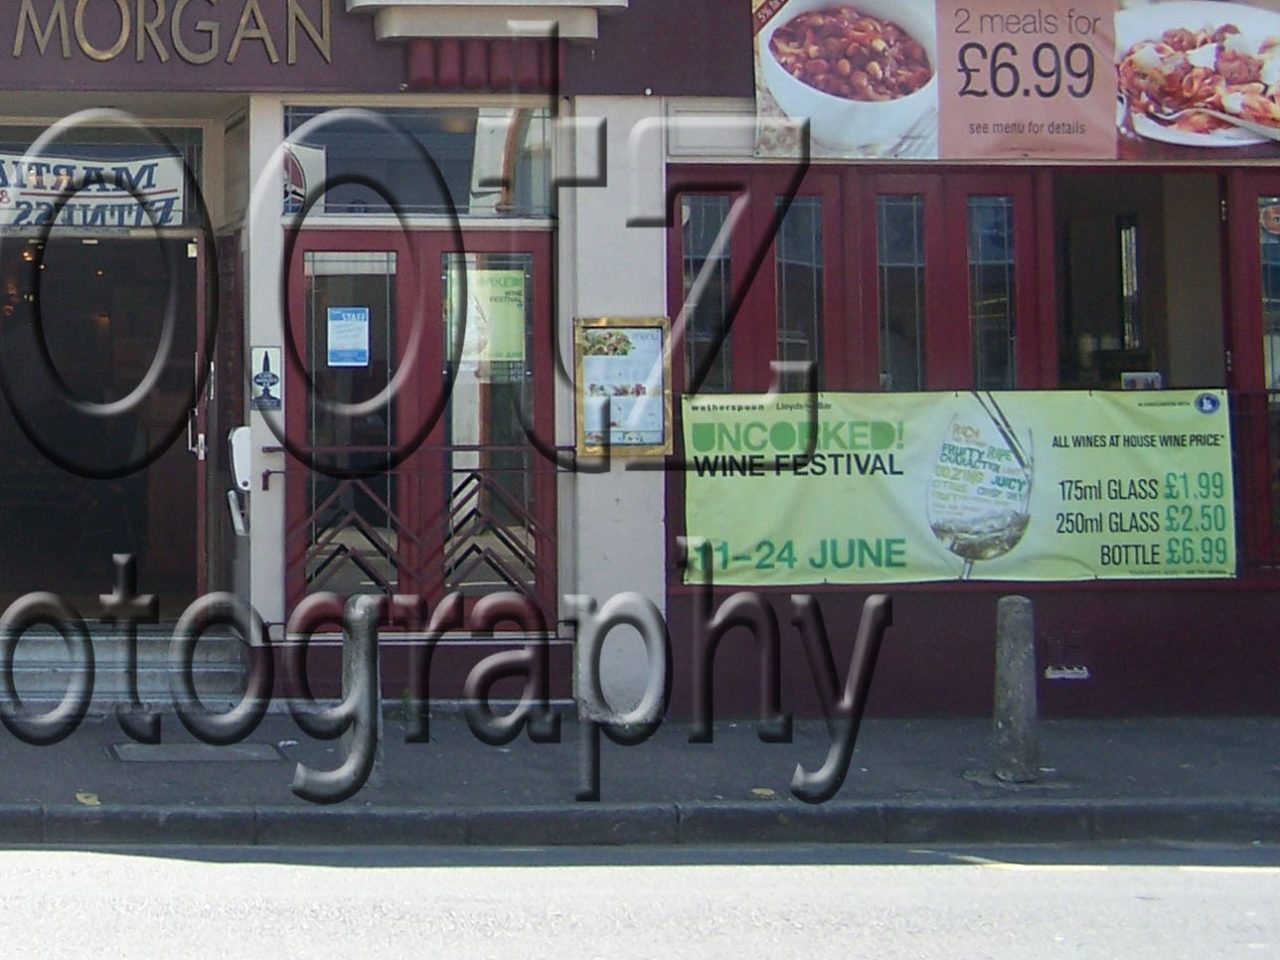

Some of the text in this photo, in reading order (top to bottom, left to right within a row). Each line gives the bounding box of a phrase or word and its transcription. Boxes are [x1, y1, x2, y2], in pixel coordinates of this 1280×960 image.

[954, 8, 1101, 35] 2 meals for
[957, 42, 1095, 98] £6.99
[969, 121, 1086, 134] see menu for details
[692, 420, 904, 452] UNCORKED!
[1052, 436, 1070, 448] ALL
[1072, 435, 1106, 448] WINES
[1108, 435, 1121, 447] AT
[1123, 435, 1157, 447] HOUSE
[1159, 434, 1187, 447] WINE
[694, 453, 904, 477] WINE FESTIVAL
[1058, 472, 1224, 501] 175ml GLASS £1.99
[1056, 505, 1226, 534] 250ml GLASS £2.50
[809, 538, 907, 569] JUNE
[1100, 537, 1228, 565] BOTTLE £6.99
